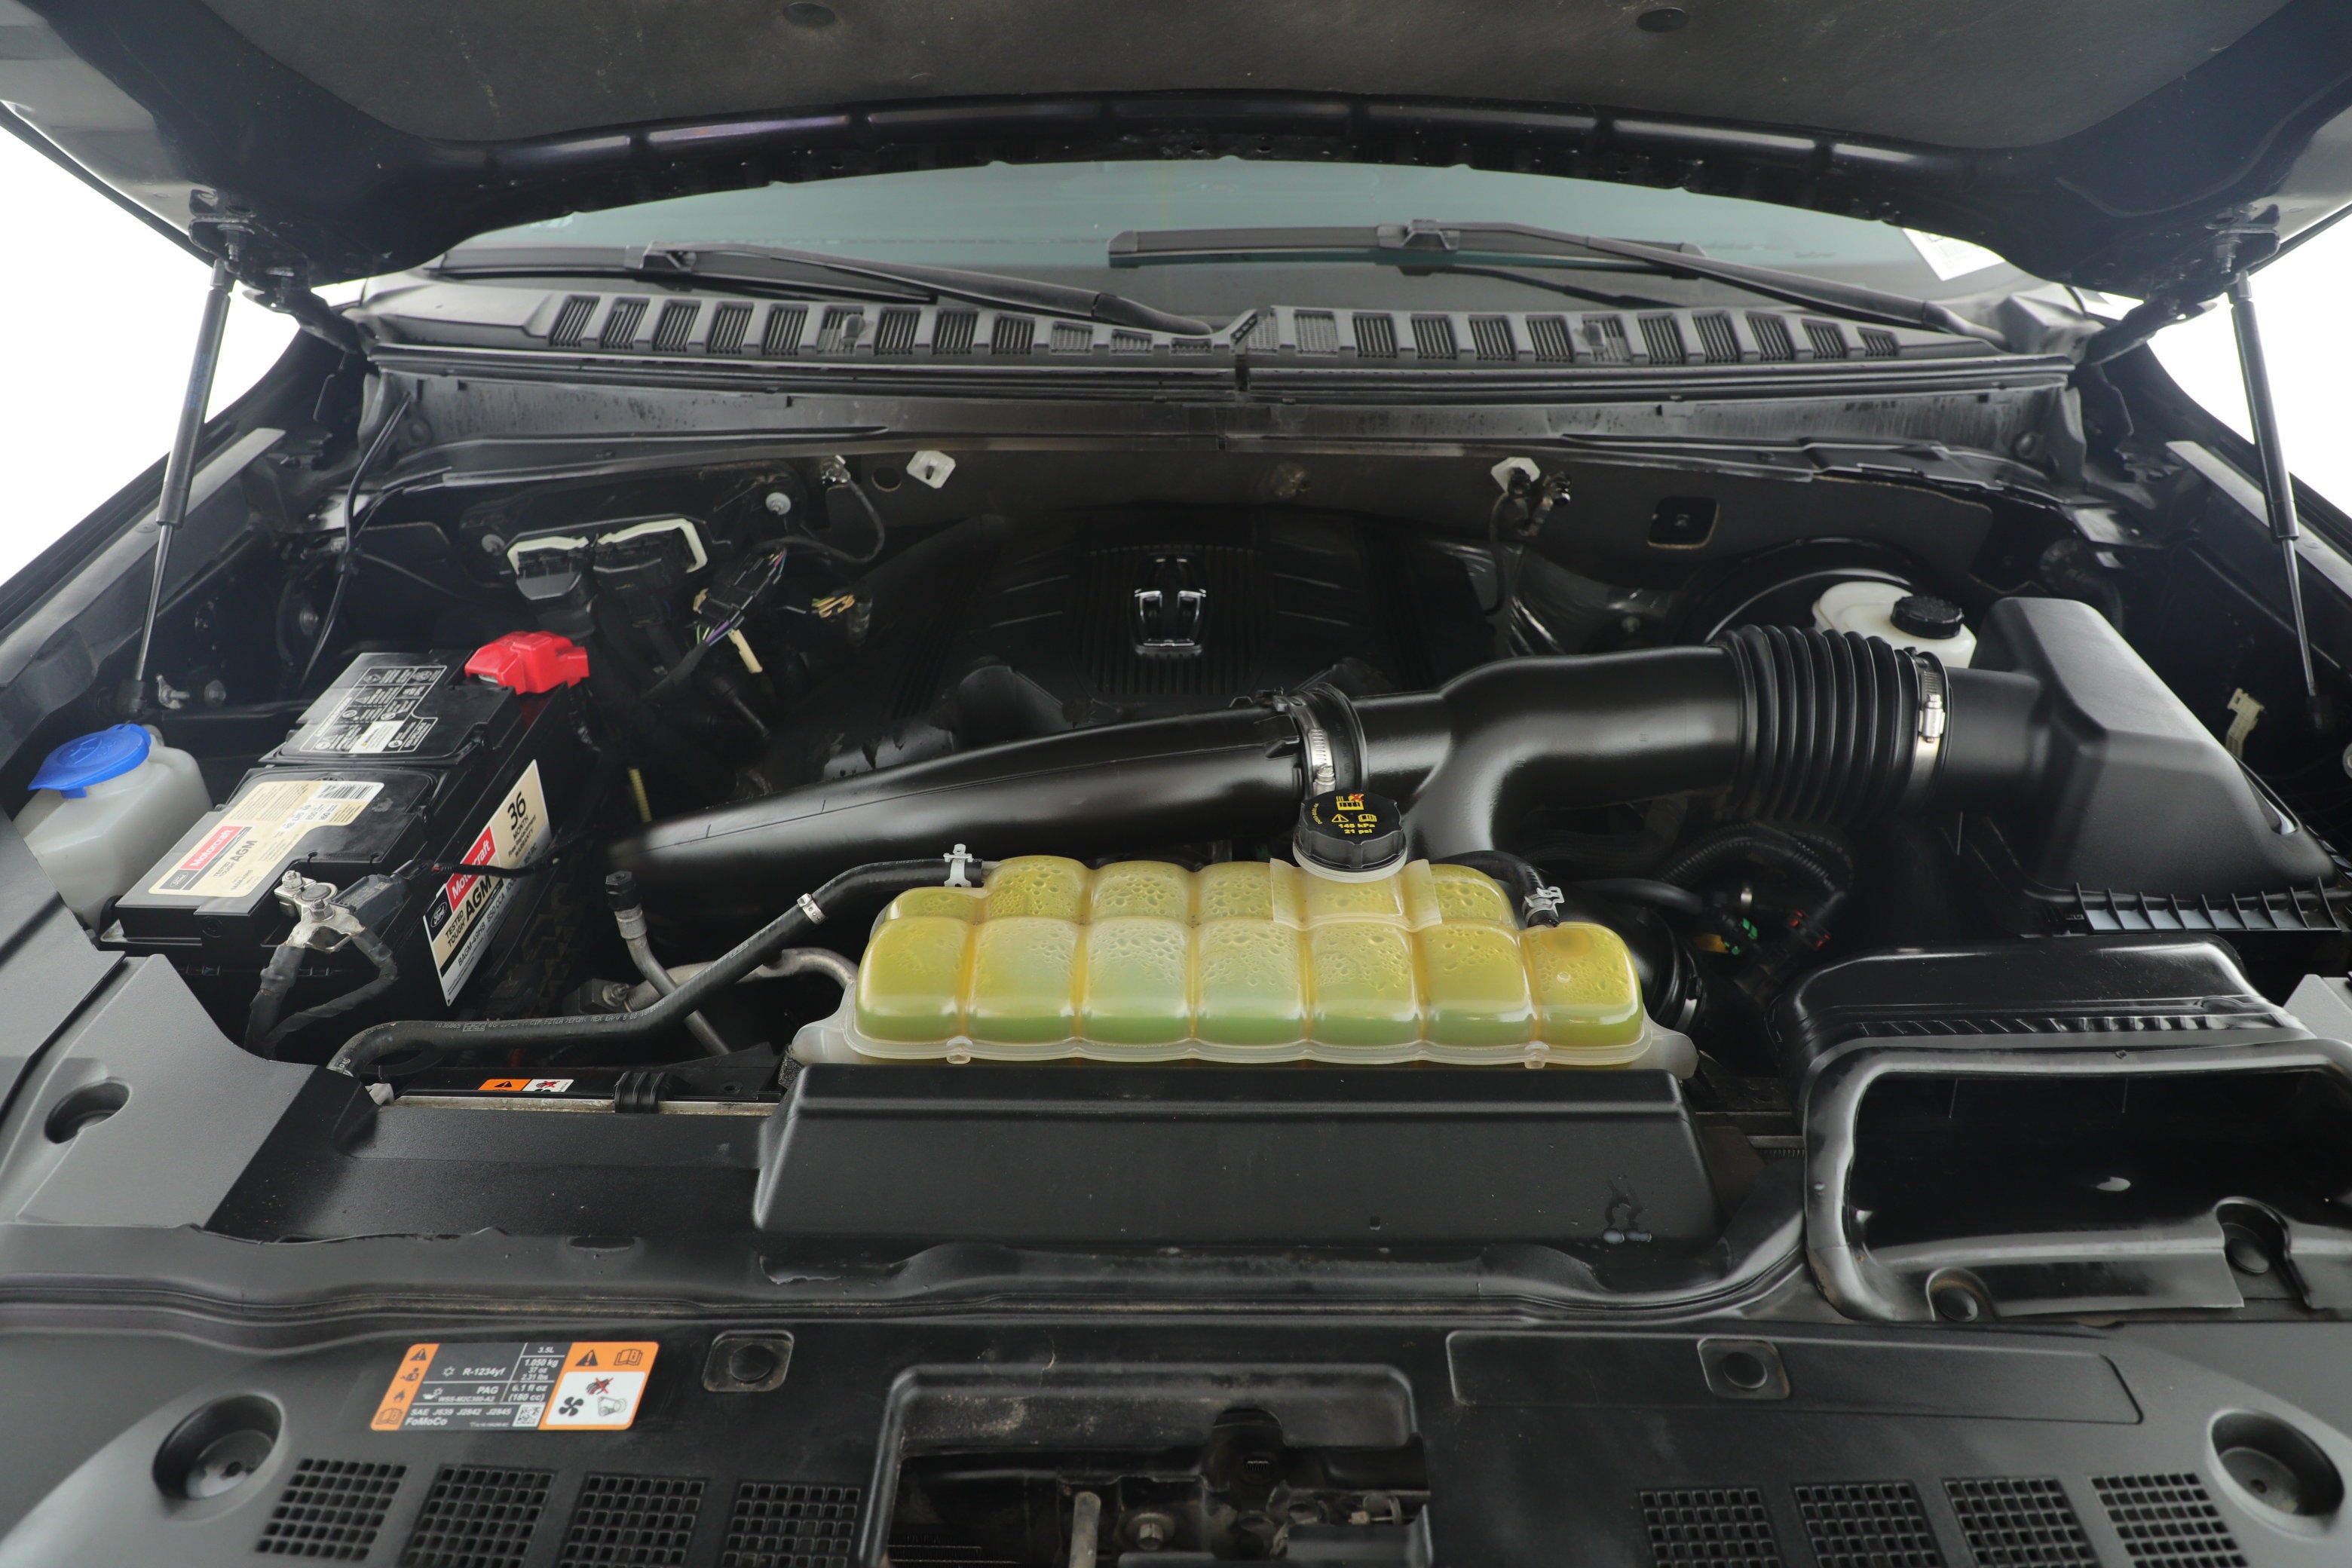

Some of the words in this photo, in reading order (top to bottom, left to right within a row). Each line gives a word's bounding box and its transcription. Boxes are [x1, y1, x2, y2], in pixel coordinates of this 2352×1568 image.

[507, 791, 526, 831] 36
[513, 814, 529, 841] MONTH
[189, 829, 234, 867] Motorcraft
[230, 840, 259, 862] AGM
[465, 874, 492, 921] AGM
[487, 907, 496, 922] 850
[495, 893, 505, 909] CCA
[446, 910, 464, 939] TESTED
[462, 1367, 507, 1377] R-1234yf
[524, 1358, 547, 1367] 1.050
[547, 1359, 559, 1368] kg
[476, 1386, 499, 1395] PAG
[507, 1393, 528, 1402] (180
[528, 1394, 545, 1402] cc)
[405, 1417, 449, 1426] FoMoCo
